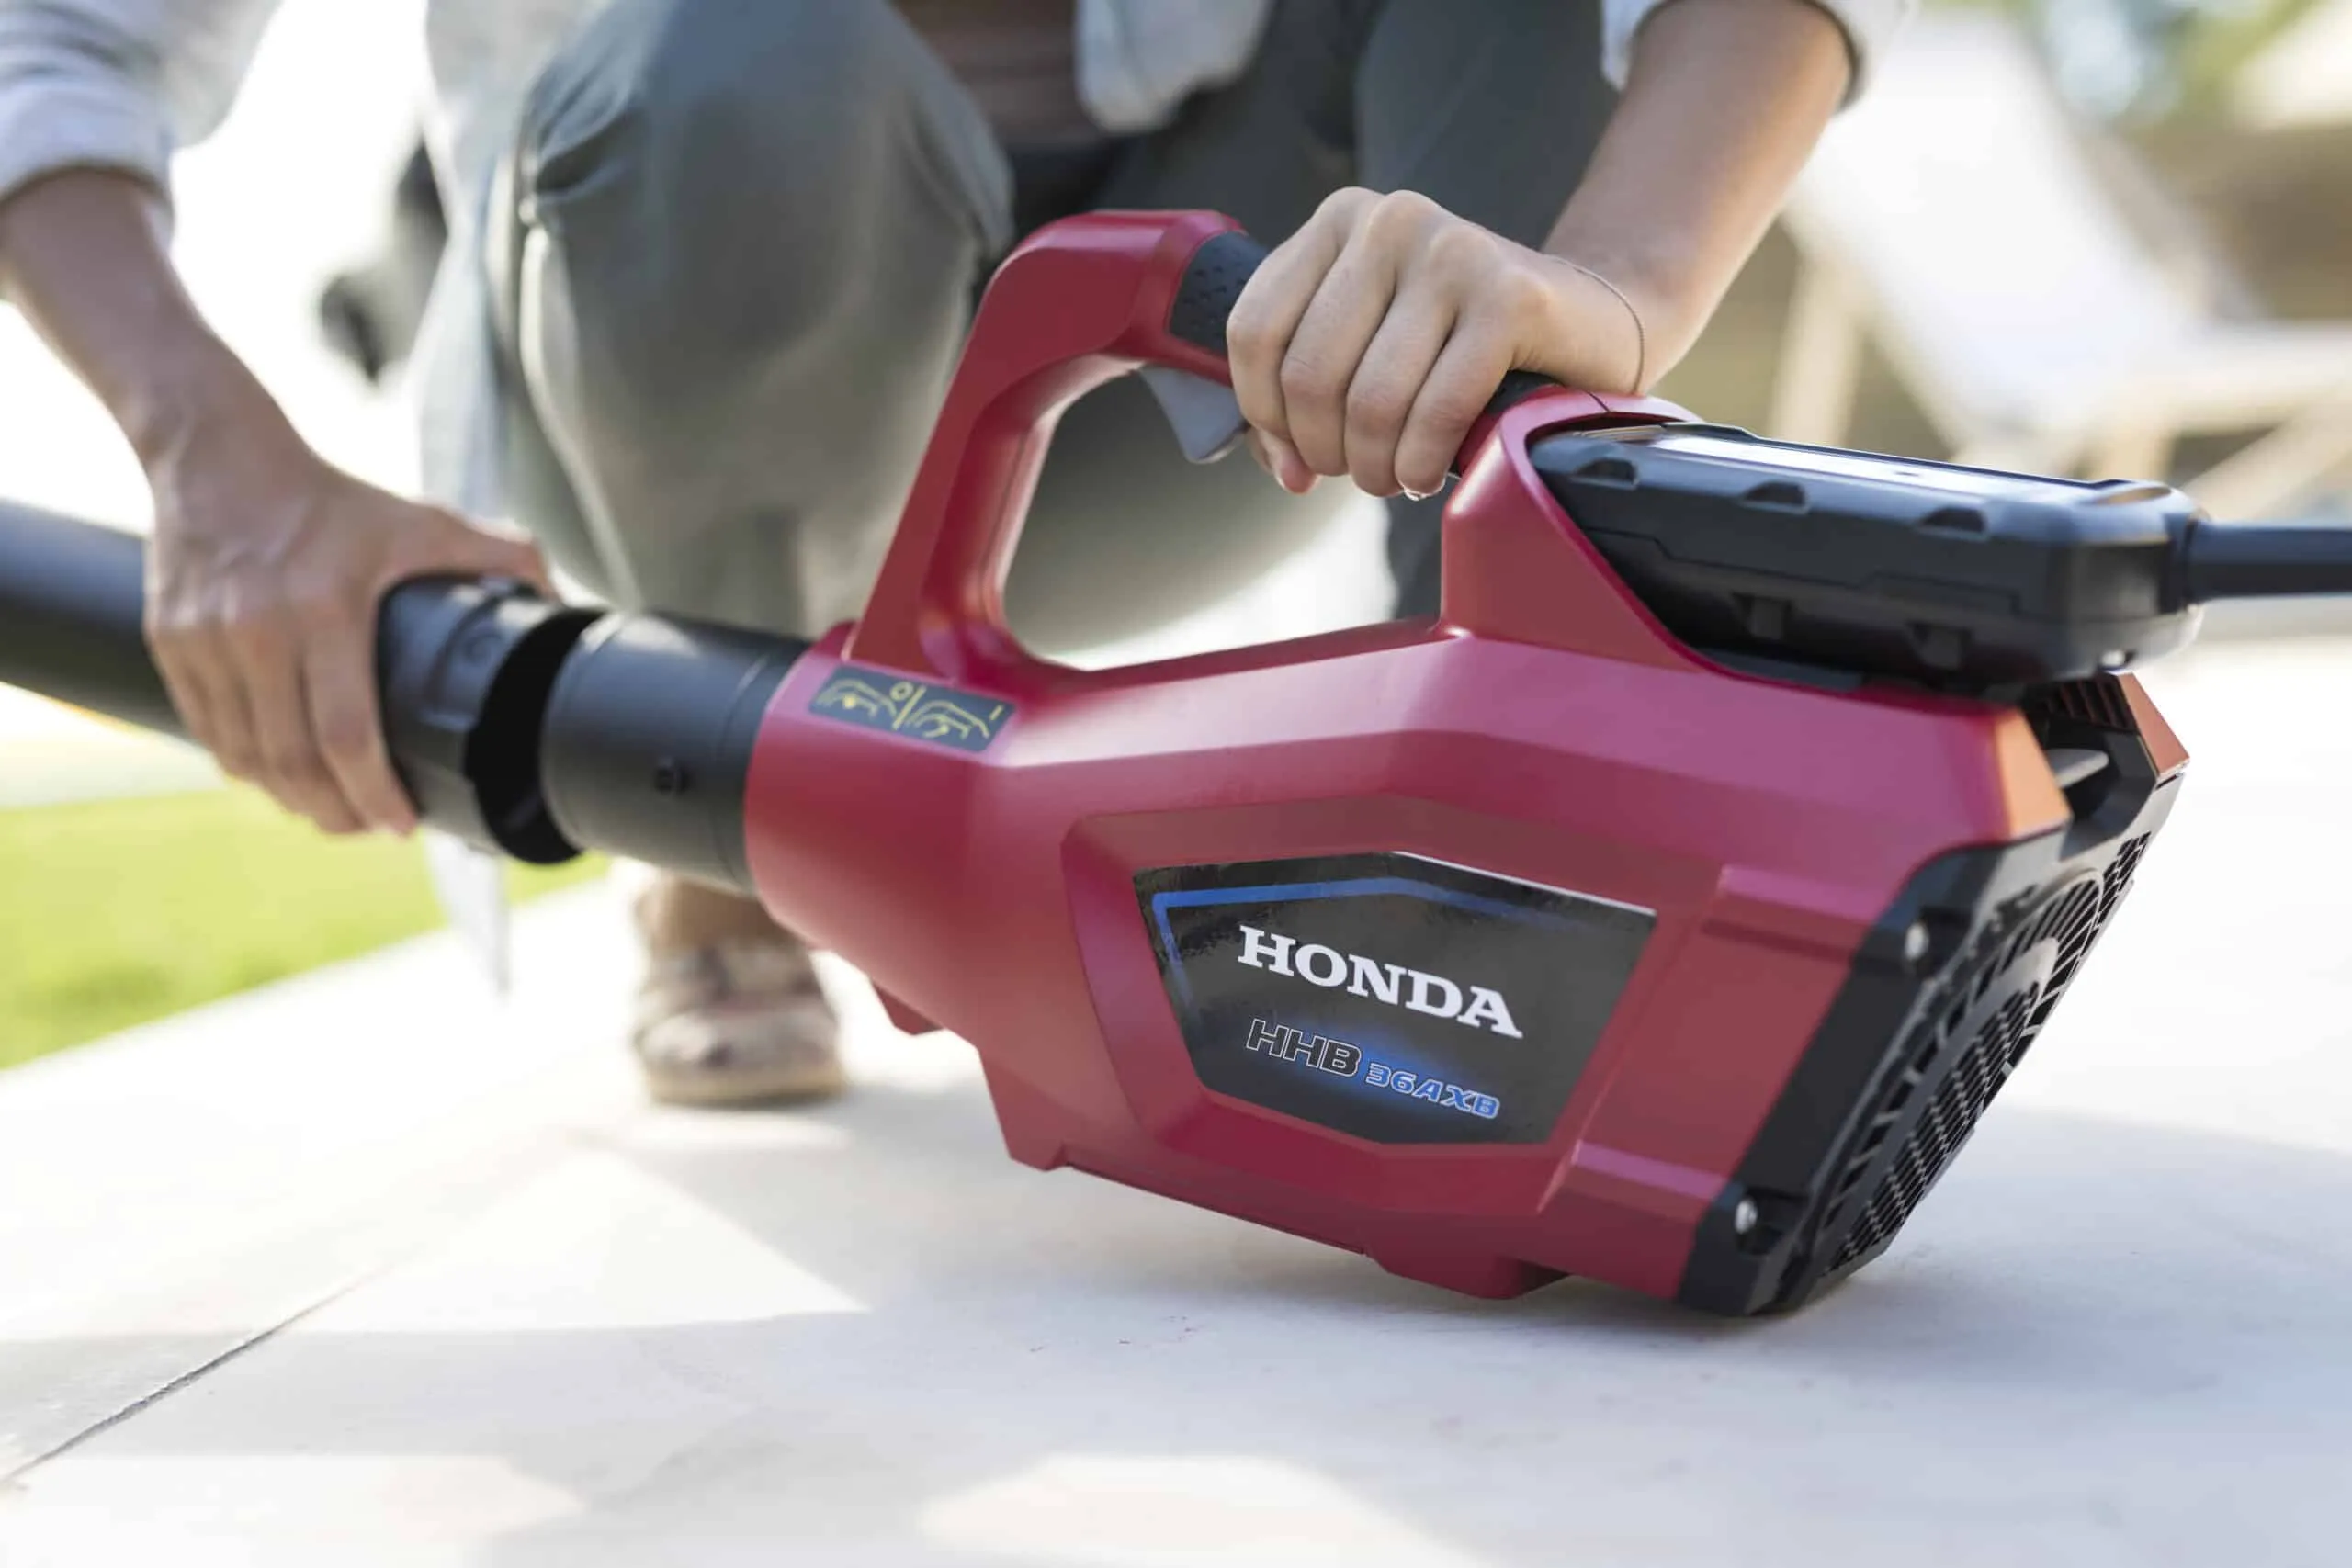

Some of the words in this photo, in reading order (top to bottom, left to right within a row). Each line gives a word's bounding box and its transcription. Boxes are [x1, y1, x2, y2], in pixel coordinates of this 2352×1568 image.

[1238, 925, 1522, 1038] HONDA
[1246, 1018, 1362, 1077] HHB
[1365, 1062, 1500, 1119] 36AXB
